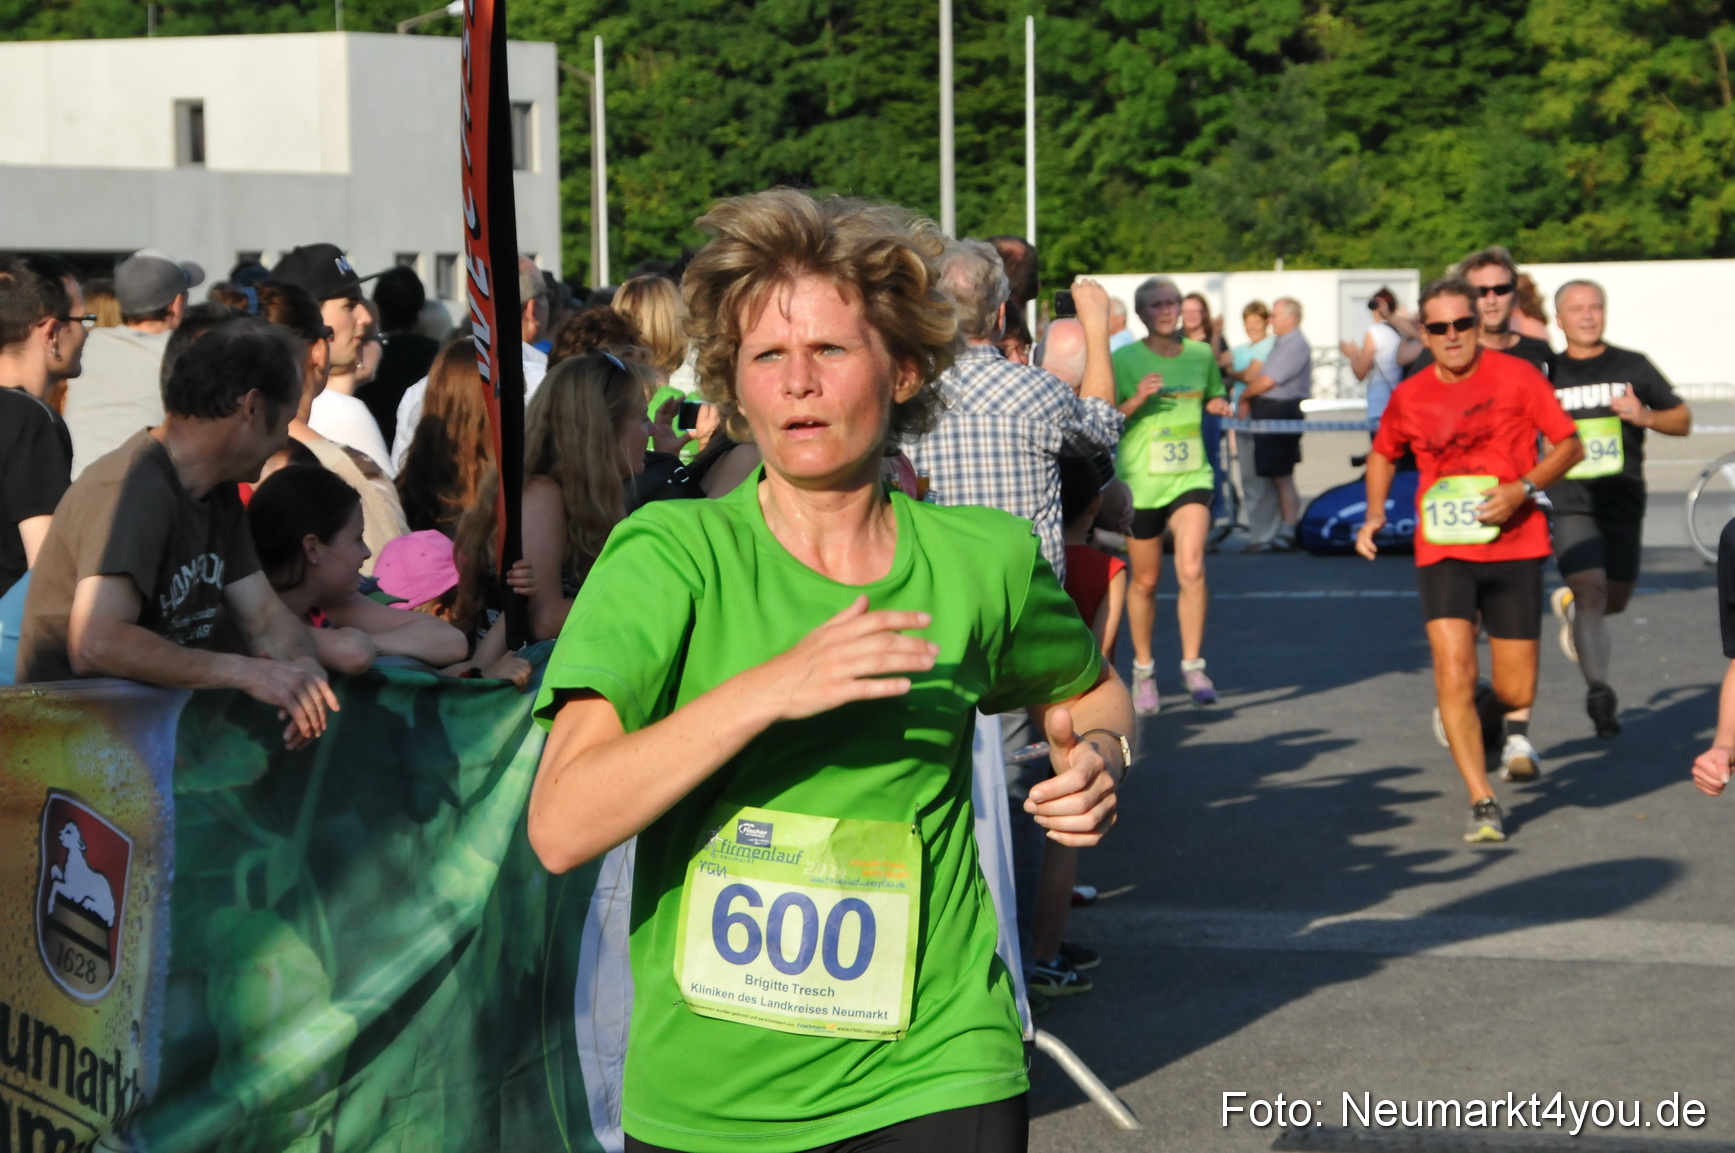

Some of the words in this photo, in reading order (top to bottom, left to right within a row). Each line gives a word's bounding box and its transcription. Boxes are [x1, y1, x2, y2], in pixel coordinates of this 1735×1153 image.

[1164, 442, 1189, 462] 33
[1426, 499, 1485, 527] 135
[721, 839, 804, 865] firmenlauf
[712, 883, 876, 981] 600
[55, 941, 96, 985] 1628
[745, 974, 789, 994] Brigitte
[792, 983, 835, 998] Tresch
[691, 983, 735, 1000] Kliniken
[738, 993, 757, 1004] des
[760, 997, 828, 1015] Landkreises
[832, 1007, 888, 1020] Neumarkt
